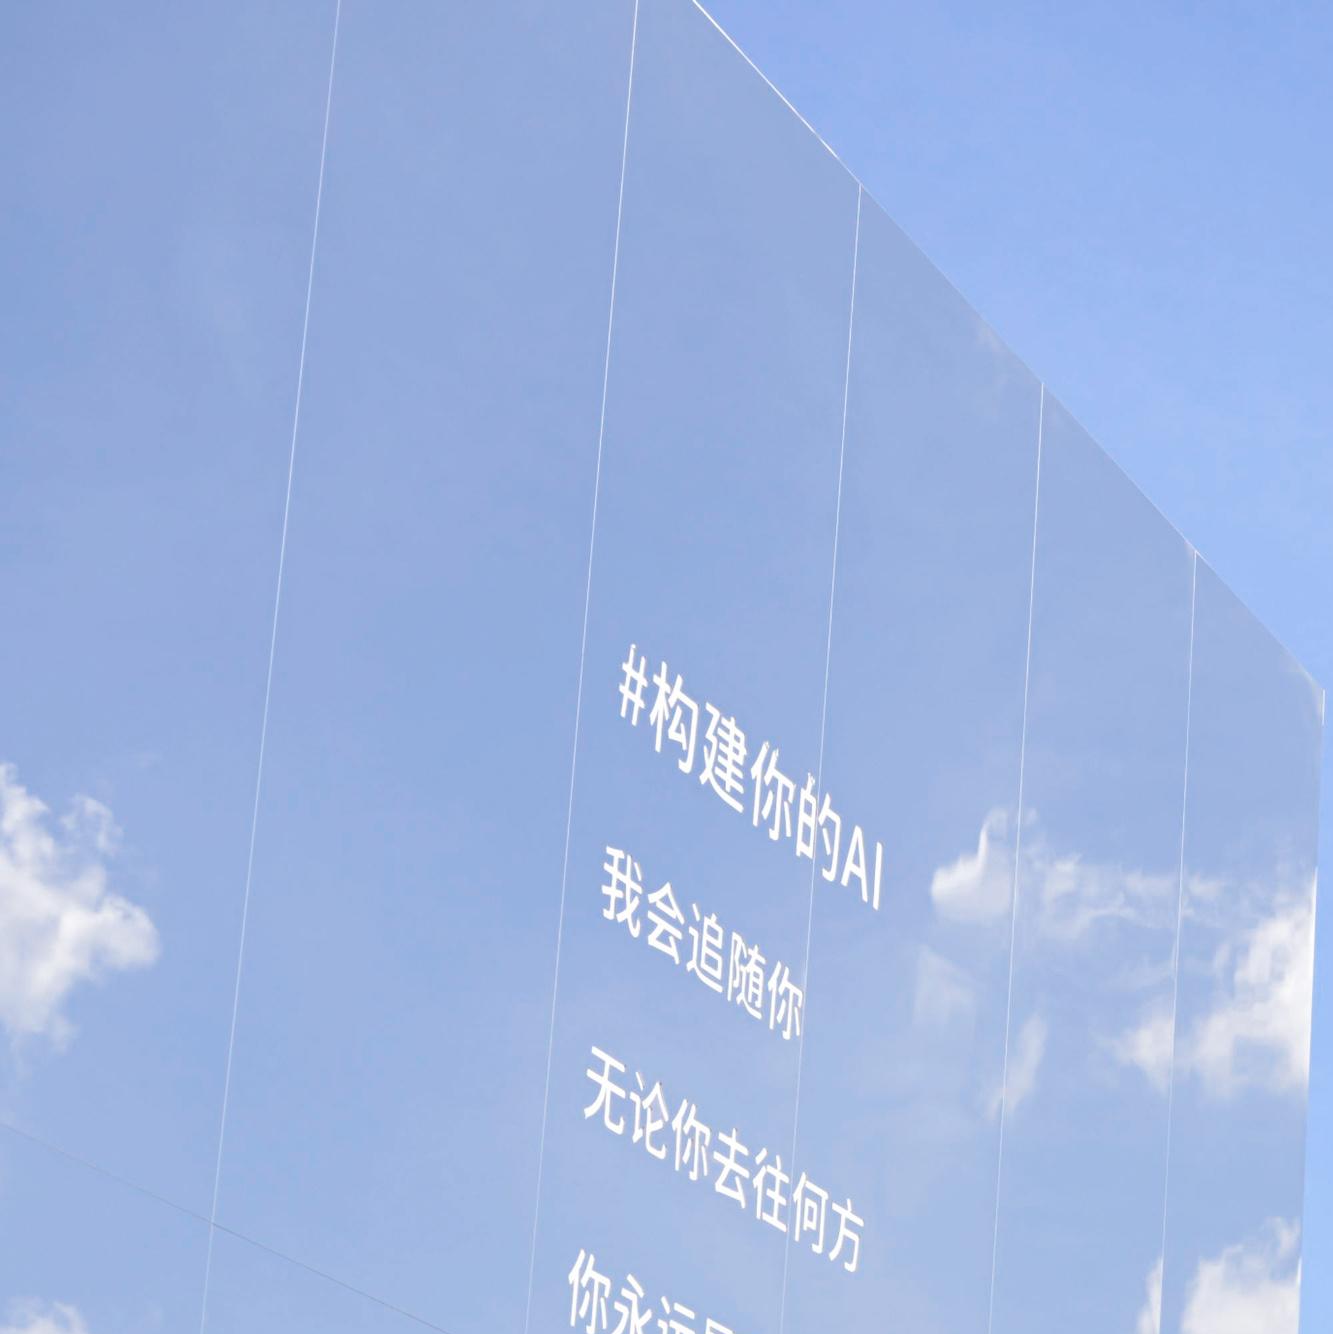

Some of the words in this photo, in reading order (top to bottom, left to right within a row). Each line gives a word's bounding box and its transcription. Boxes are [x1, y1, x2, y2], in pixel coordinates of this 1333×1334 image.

[618, 643, 885, 911] #构建你的AI
[601, 846, 804, 1041] 我会追随你
[583, 1046, 865, 1274] 无论你去往何方
